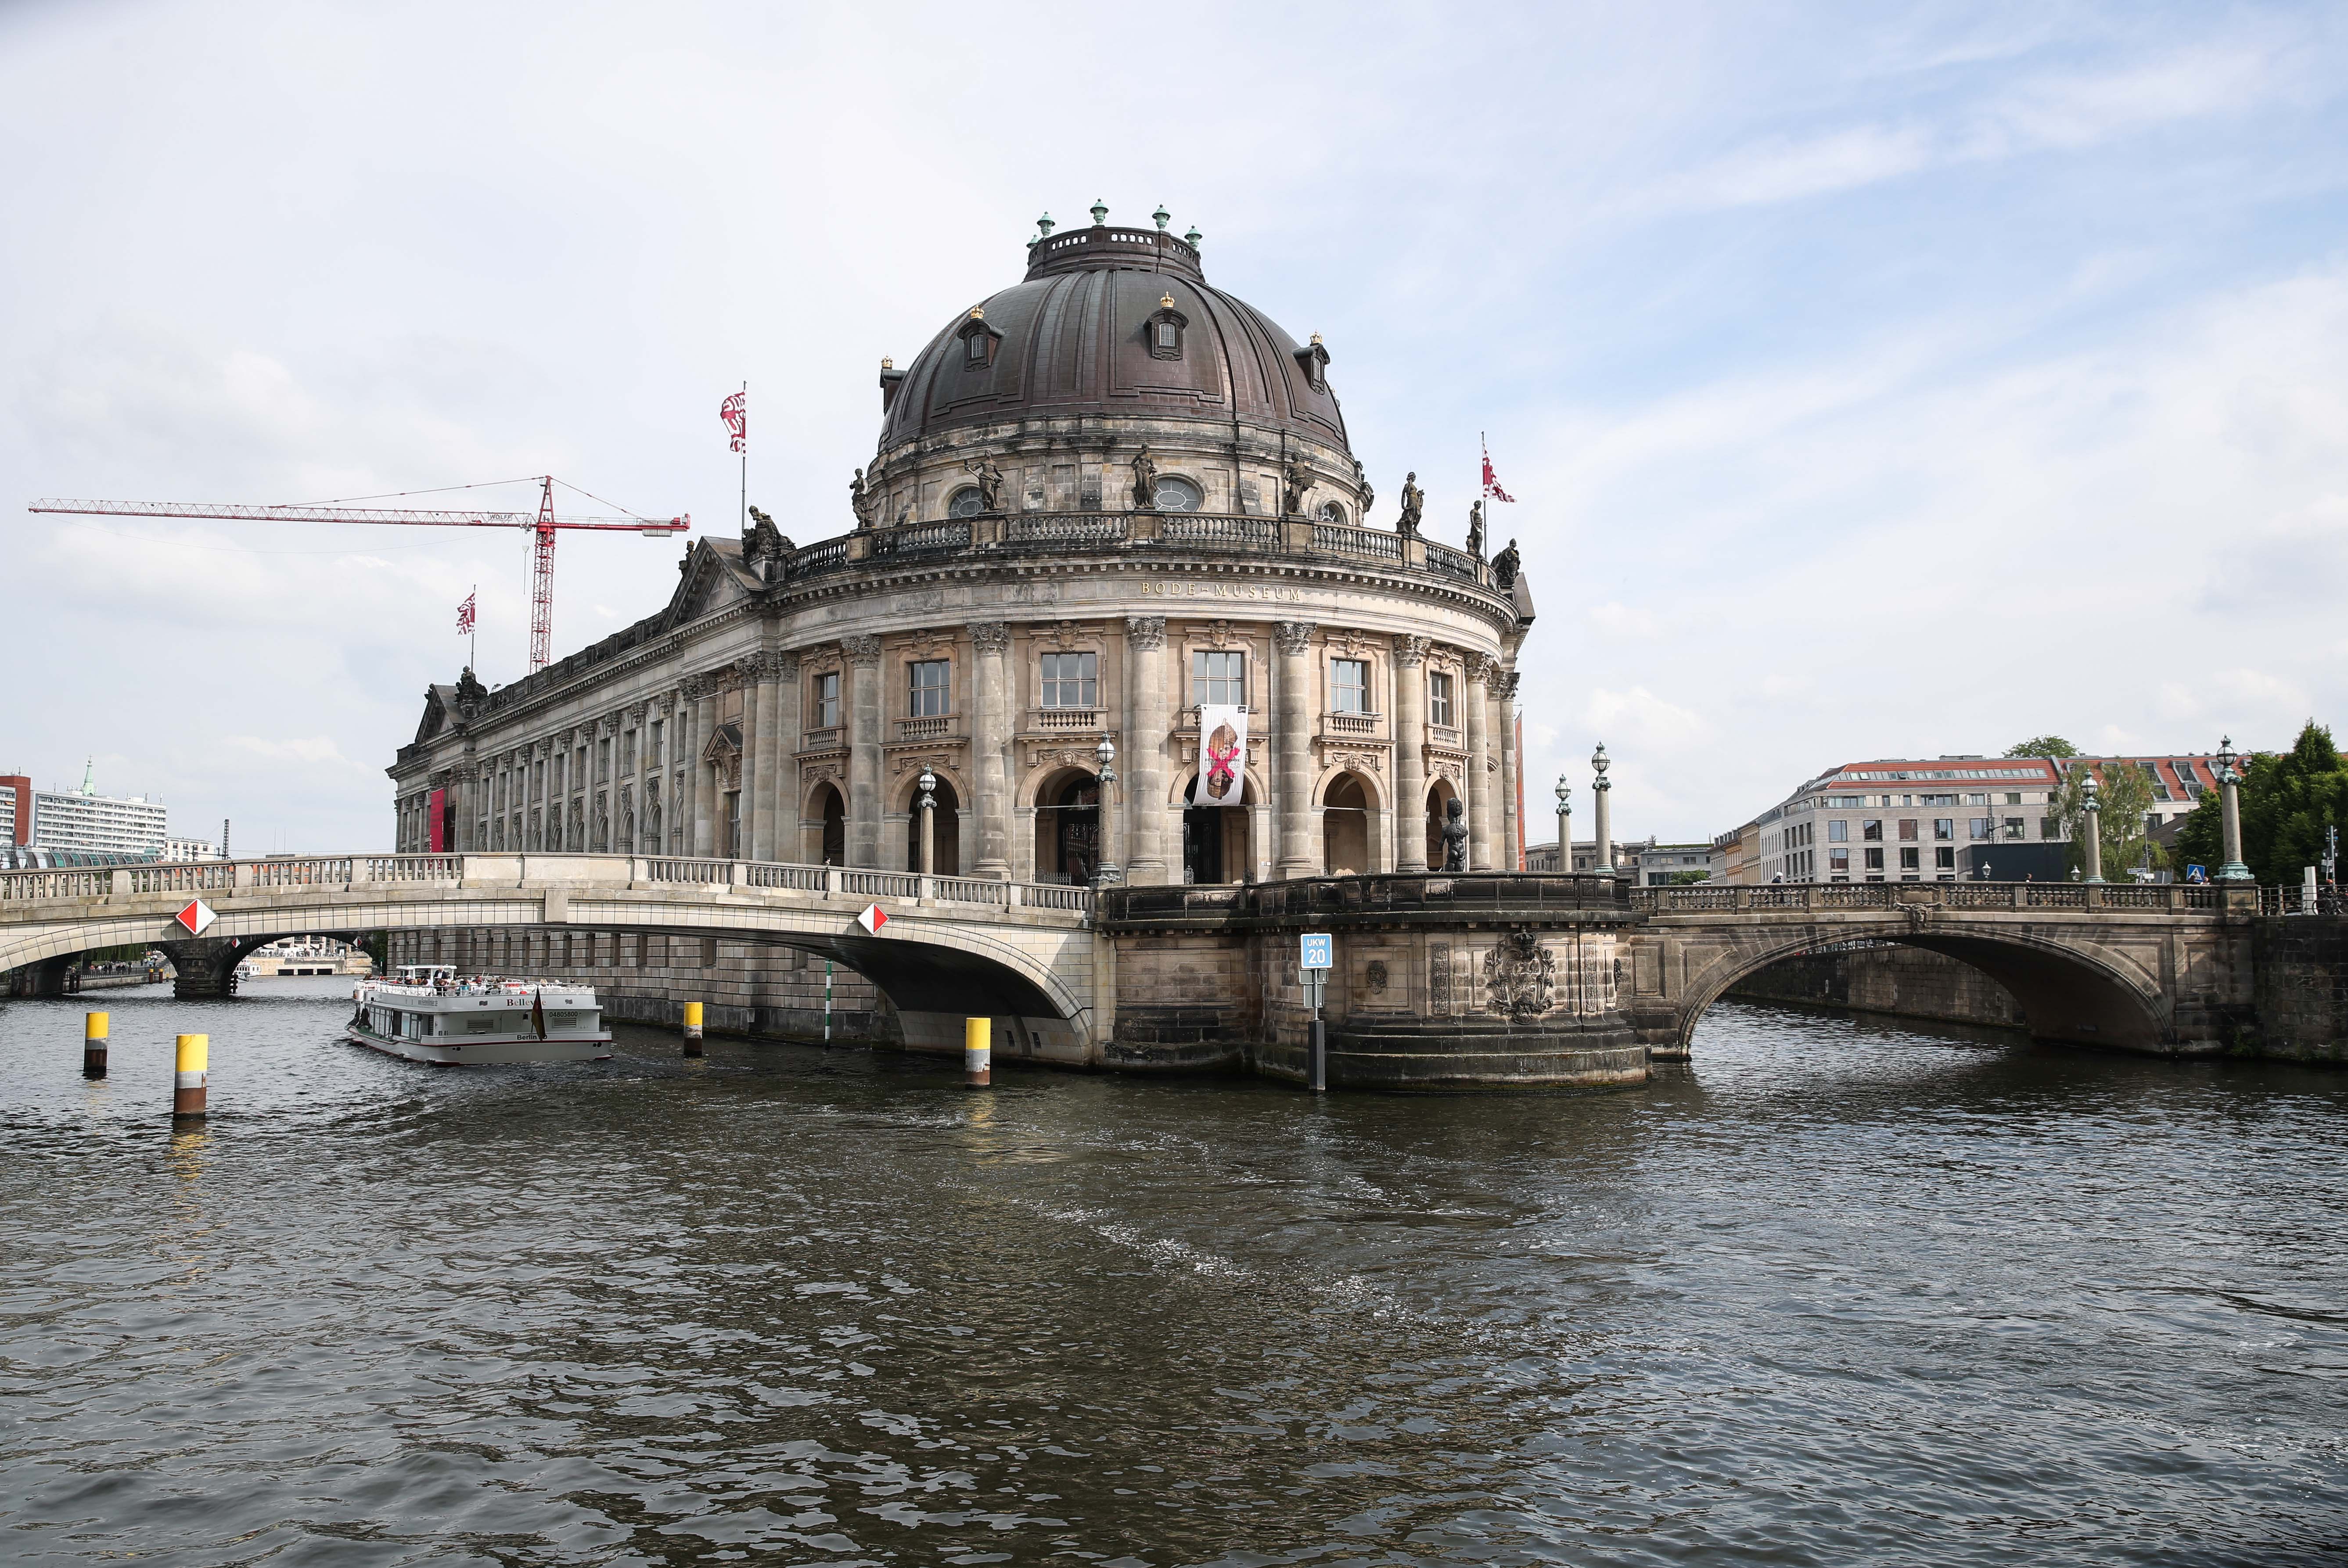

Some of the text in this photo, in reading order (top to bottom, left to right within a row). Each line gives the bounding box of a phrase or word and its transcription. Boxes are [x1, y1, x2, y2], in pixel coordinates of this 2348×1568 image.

[1141, 582, 1302, 601] BODE-MUSEUM
[1307, 938, 1326, 947] UKW
[1308, 948, 1326, 964] 20
